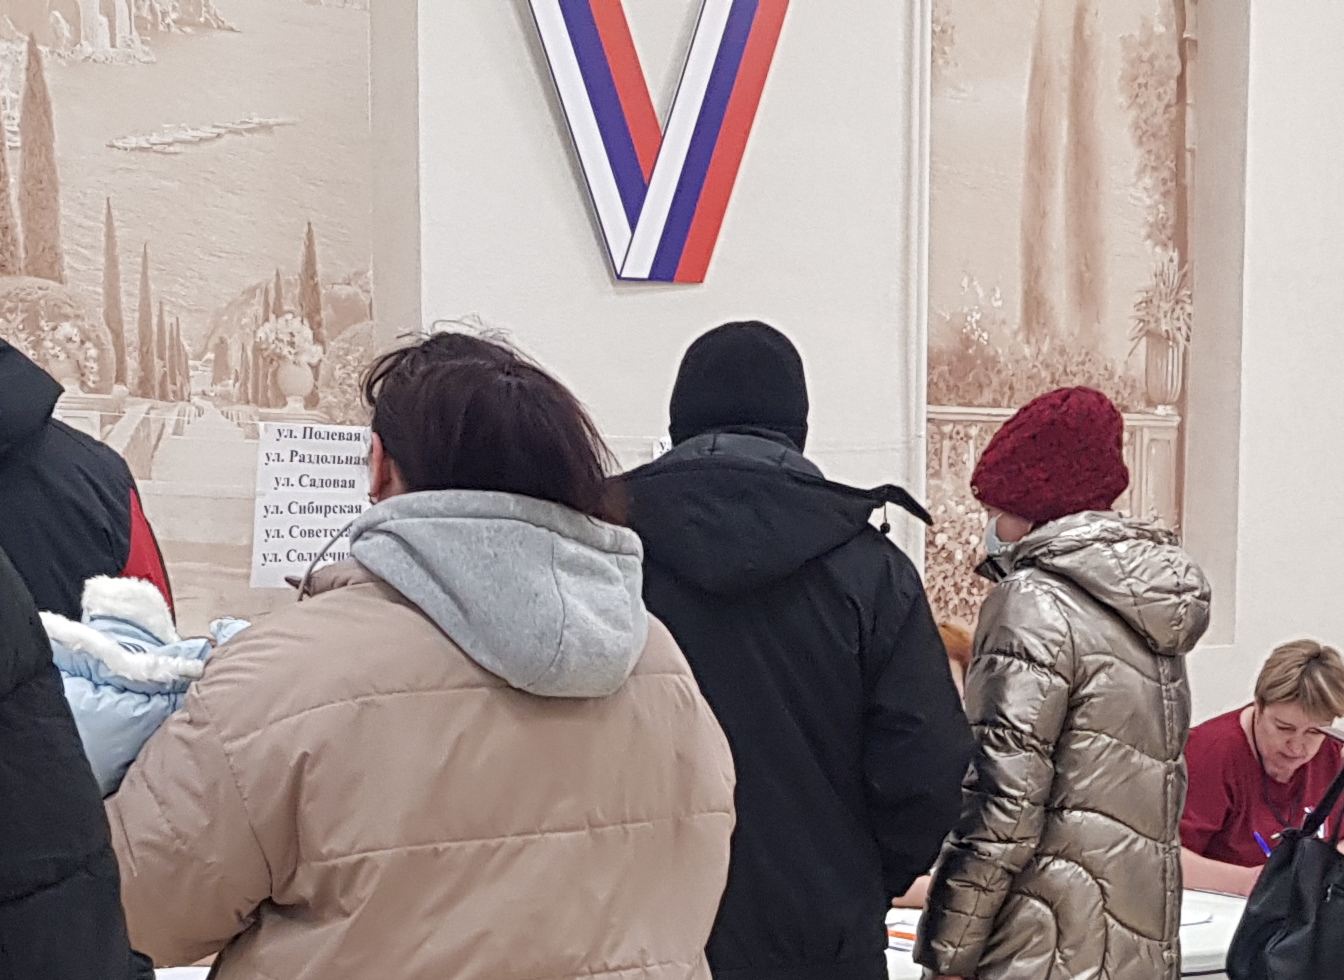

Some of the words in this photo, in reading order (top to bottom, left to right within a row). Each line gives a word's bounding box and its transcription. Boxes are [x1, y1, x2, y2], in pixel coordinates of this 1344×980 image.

[276, 428, 298, 442] ул.
[301, 426, 361, 442] Полевая
[264, 451, 285, 466] ул.
[274, 475, 294, 490] ул.
[298, 473, 356, 489] Садовая
[263, 503, 283, 518] ул.
[287, 501, 362, 517] Сибирская
[264, 528, 285, 542] ул.
[261, 552, 282, 566] ул.
